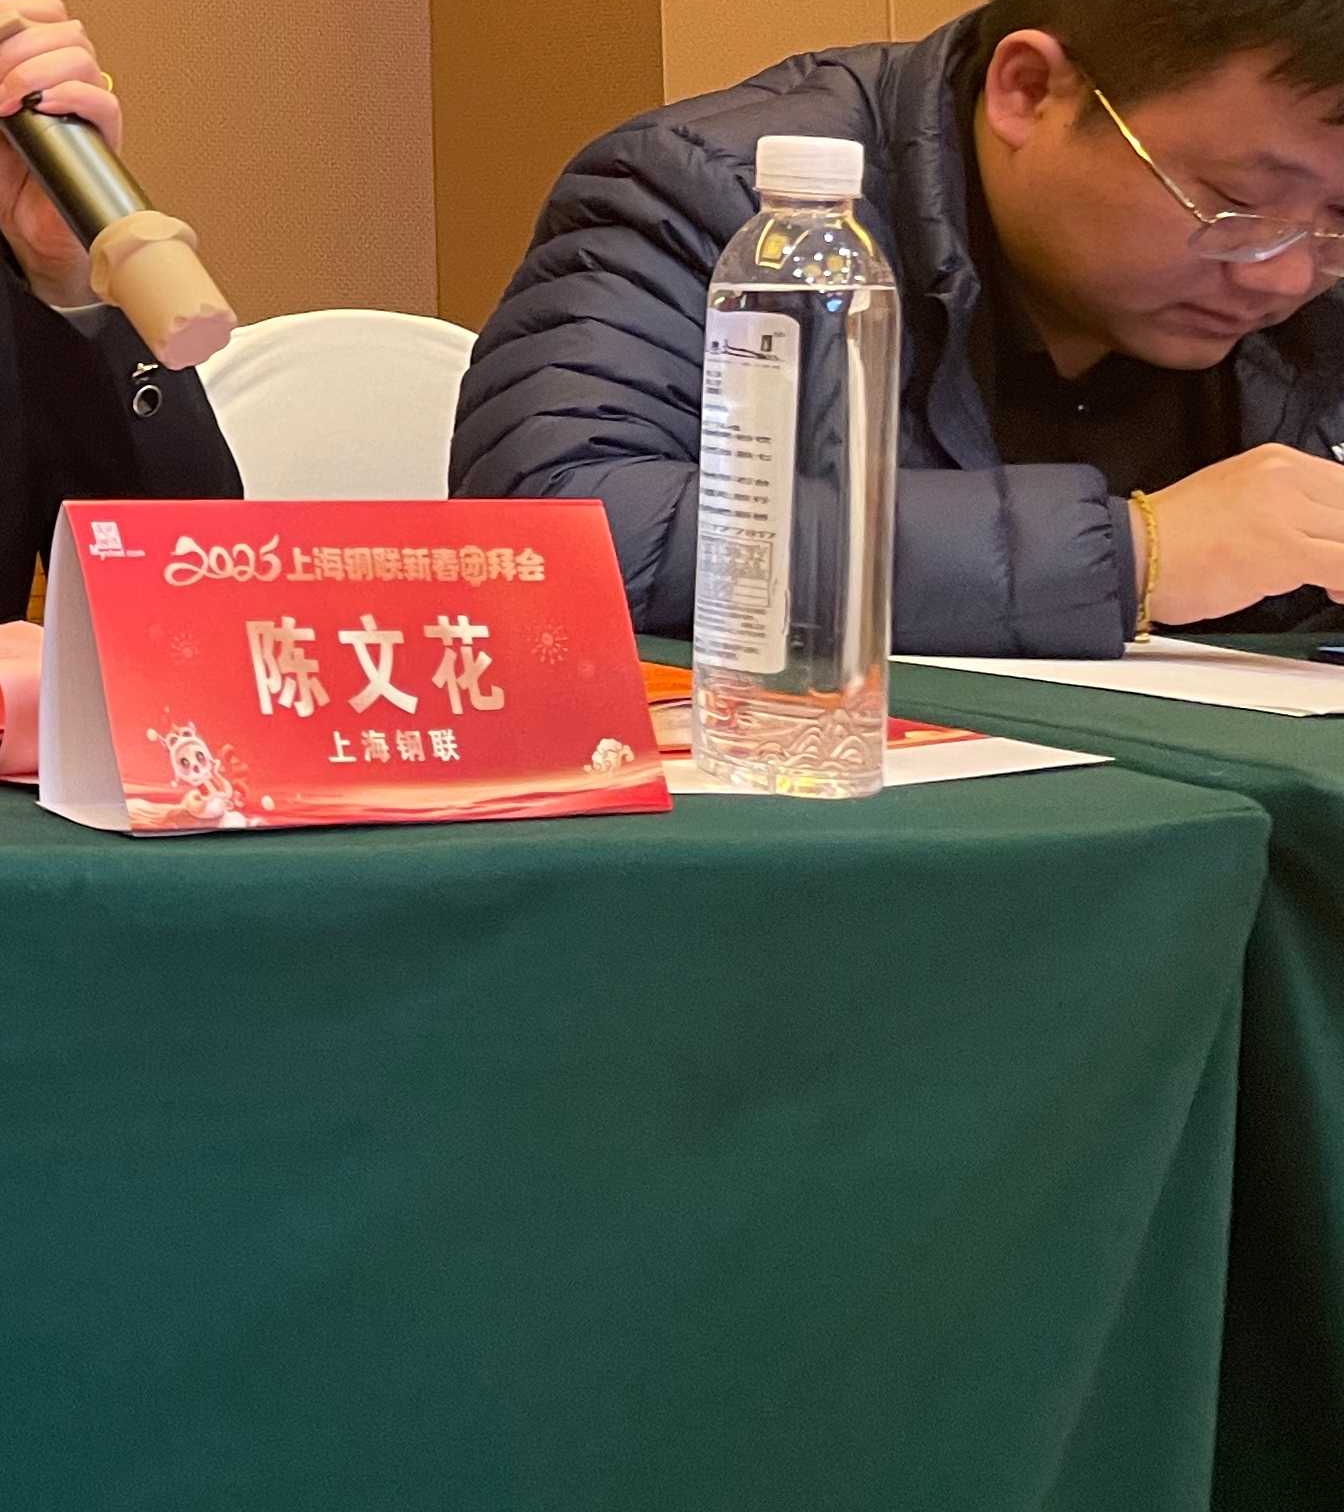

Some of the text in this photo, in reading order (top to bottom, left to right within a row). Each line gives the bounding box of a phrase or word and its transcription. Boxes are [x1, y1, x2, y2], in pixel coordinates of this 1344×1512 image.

[245, 613, 505, 718] 陈文花
[327, 728, 461, 763] 上海钢联
